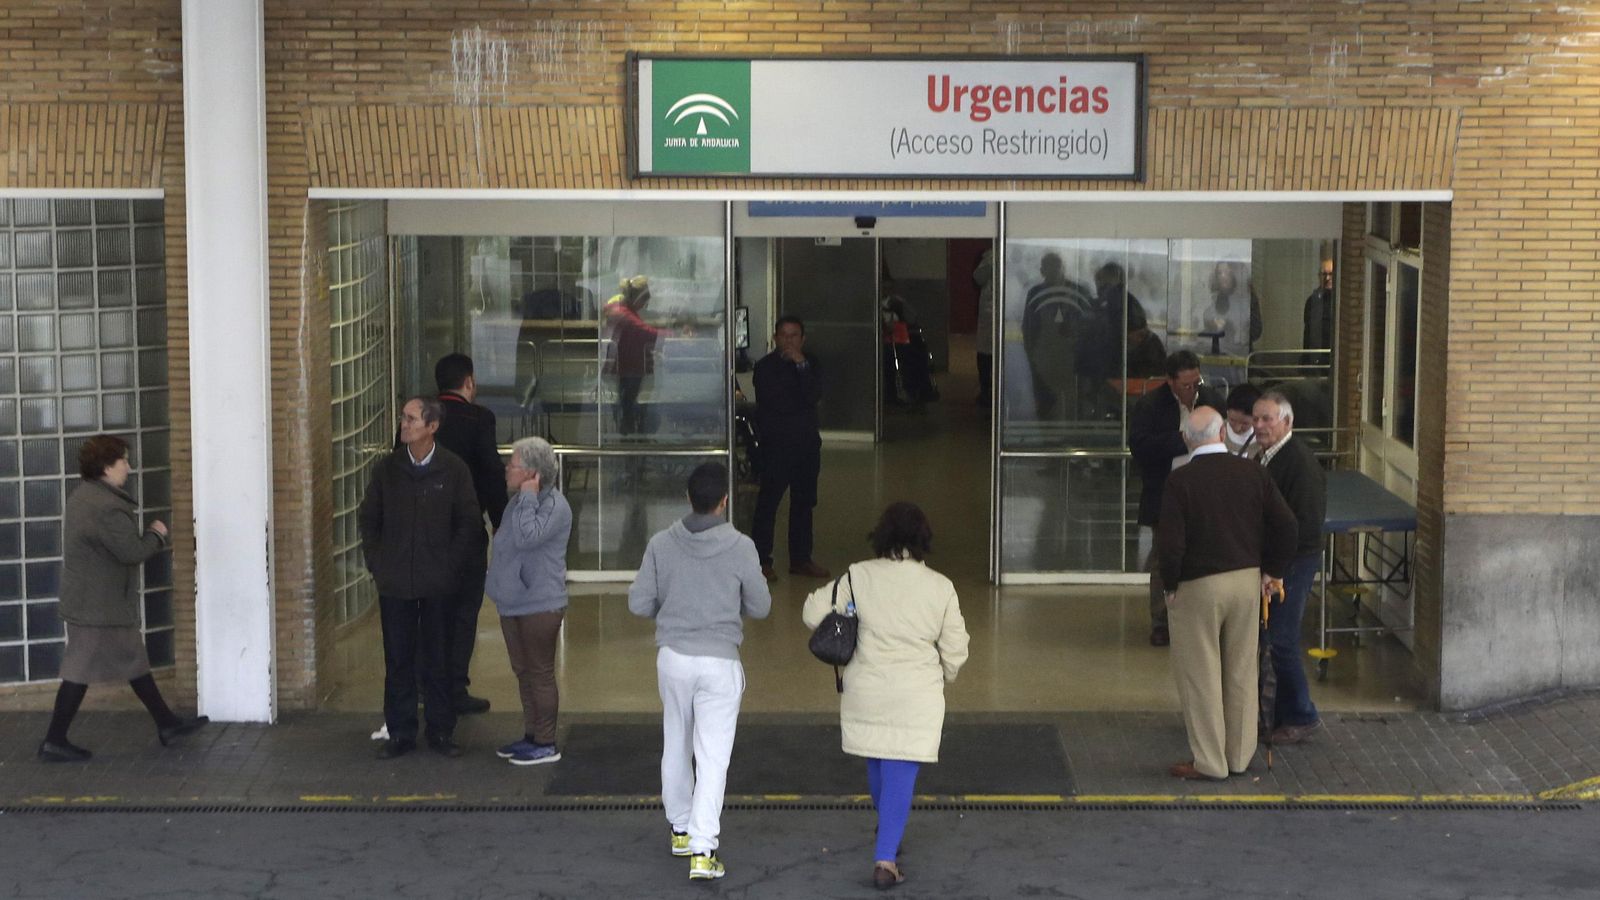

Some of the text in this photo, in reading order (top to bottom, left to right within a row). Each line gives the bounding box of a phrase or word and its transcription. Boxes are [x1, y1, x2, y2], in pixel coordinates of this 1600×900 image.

[927, 75, 1109, 122] Urgencias
[664, 137, 740, 148] JUNTA DE ANDALUCIA
[890, 127, 1109, 160] (Acceso Restringido)
